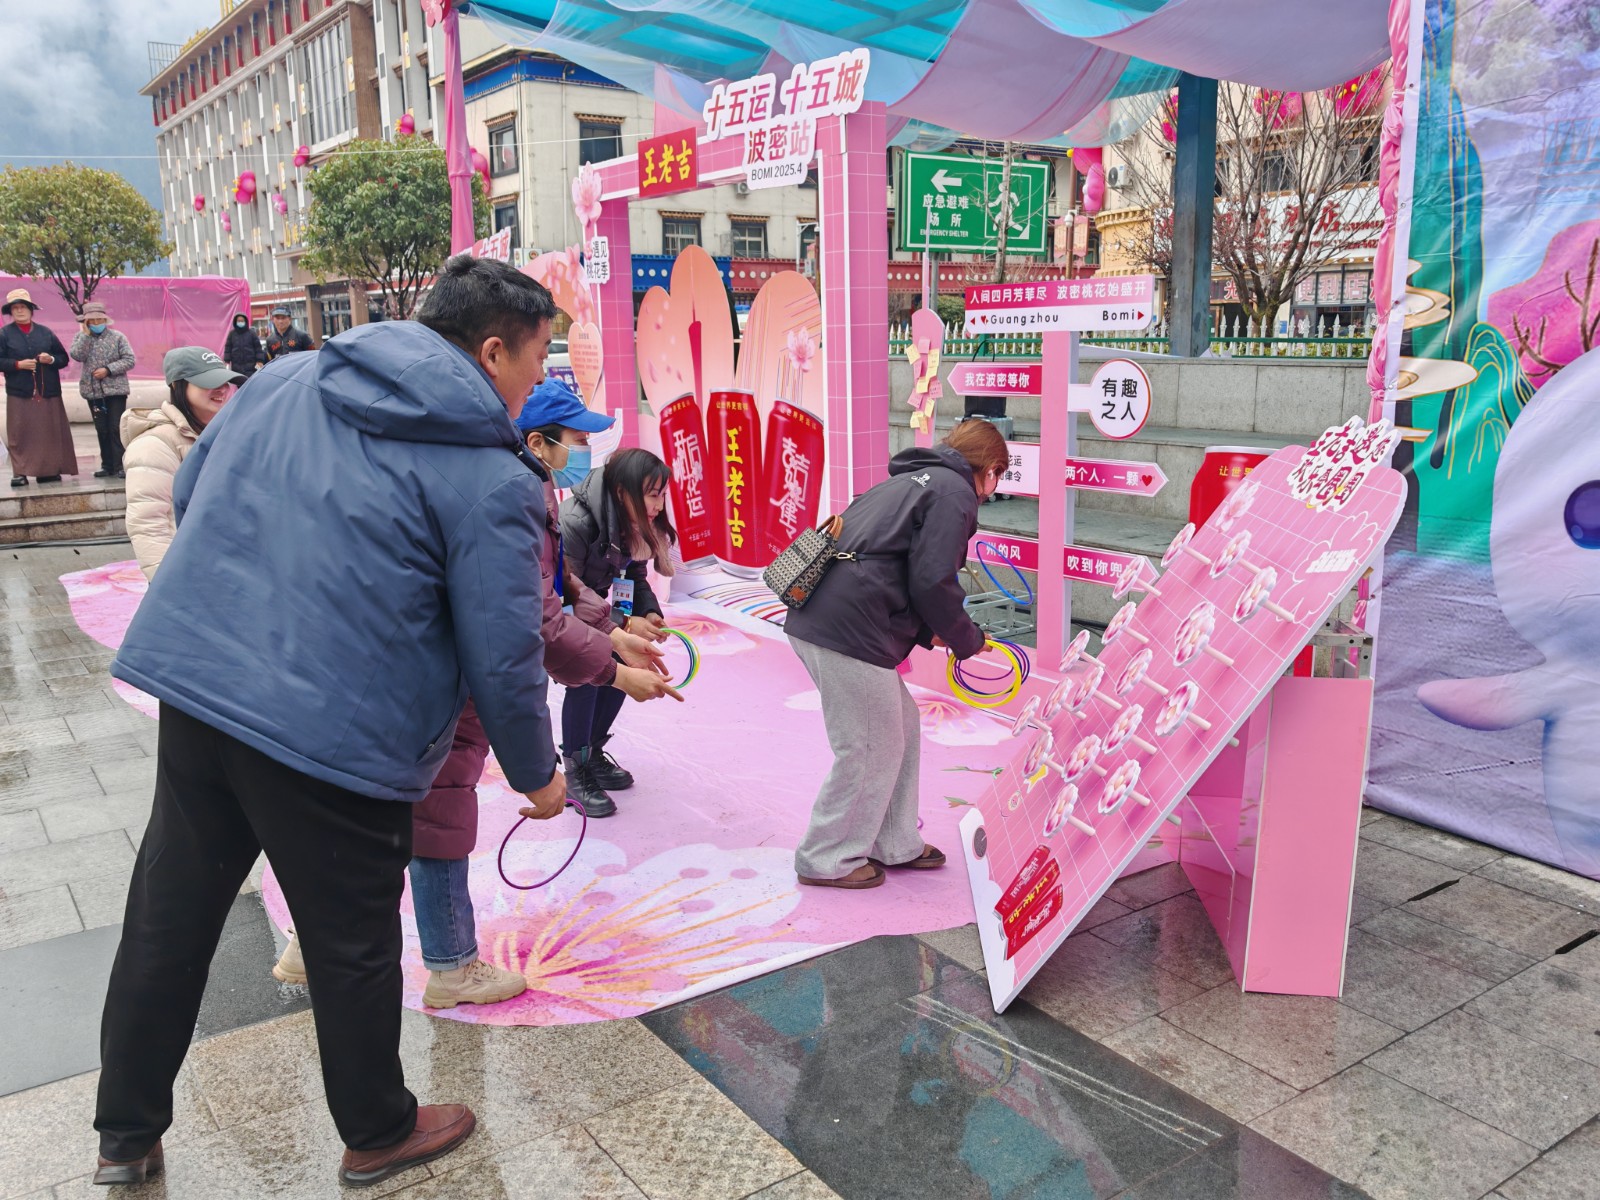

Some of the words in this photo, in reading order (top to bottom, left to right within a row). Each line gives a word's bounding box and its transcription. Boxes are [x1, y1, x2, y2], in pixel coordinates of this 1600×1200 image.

[707, 83, 771, 132] 十五运
[785, 58, 864, 115] 十五城
[747, 119, 811, 165] 波密站
[642, 139, 693, 188] 王老吉
[751, 166, 773, 181] BOMI
[774, 163, 803, 177] 2025.4
[922, 193, 969, 209] 应急避难
[970, 286, 1048, 305] 人间四月芳菲尽
[1056, 280, 1147, 301] 波密桃花始盛开
[1102, 308, 1136, 322] Bomi
[964, 372, 1031, 388] 我在波密等你
[1101, 377, 1138, 399] 有趣
[1101, 400, 1136, 422] 之人
[725, 427, 746, 549] 王老吉
